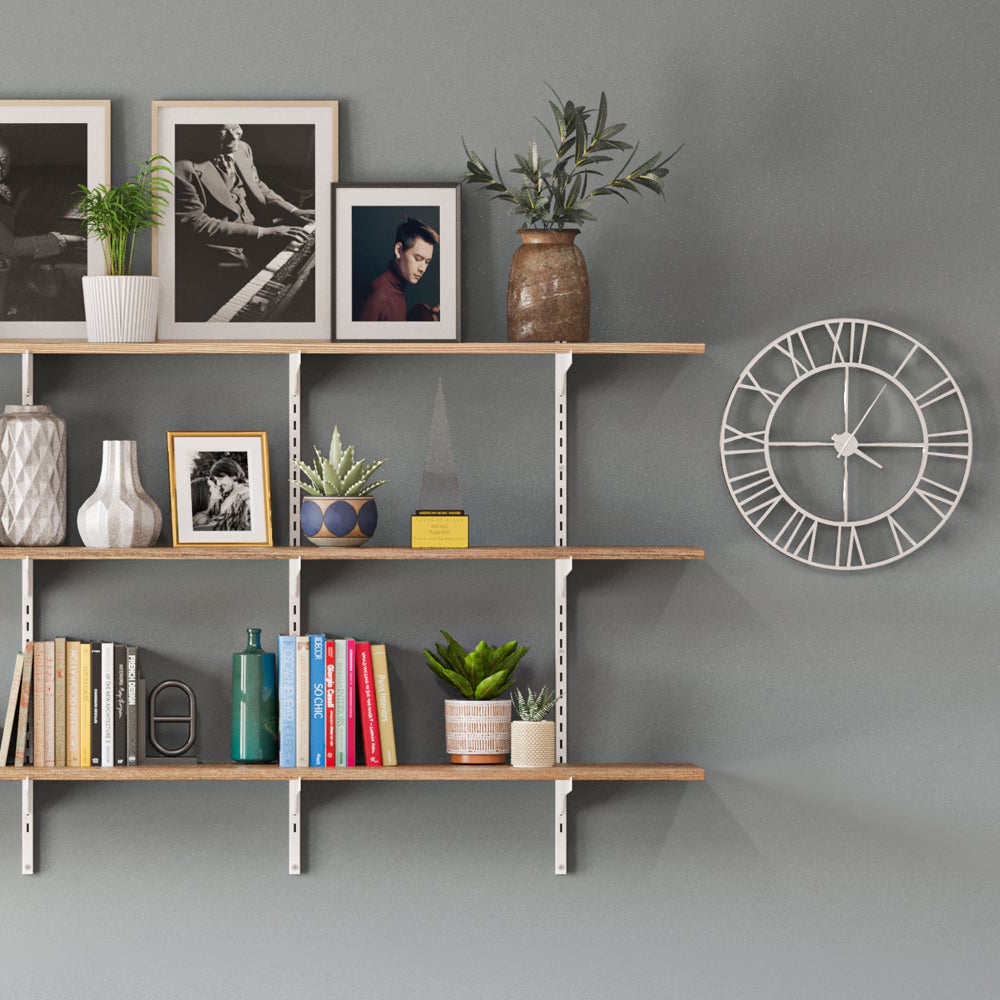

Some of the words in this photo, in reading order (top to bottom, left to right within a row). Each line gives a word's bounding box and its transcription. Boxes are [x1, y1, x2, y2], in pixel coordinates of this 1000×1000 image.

[70, 650, 78, 705] HOLLYWOOD
[128, 655, 136, 680] FRENCH
[326, 664, 334, 688] Giorgio
[128, 682, 136, 705] DESIGN
[314, 683, 323, 696] SO
[378, 674, 386, 692] Paris
[314, 697, 323, 718] CHIC
[380, 694, 388, 722] Interiors
[70, 707, 78, 752] INTERIORS
